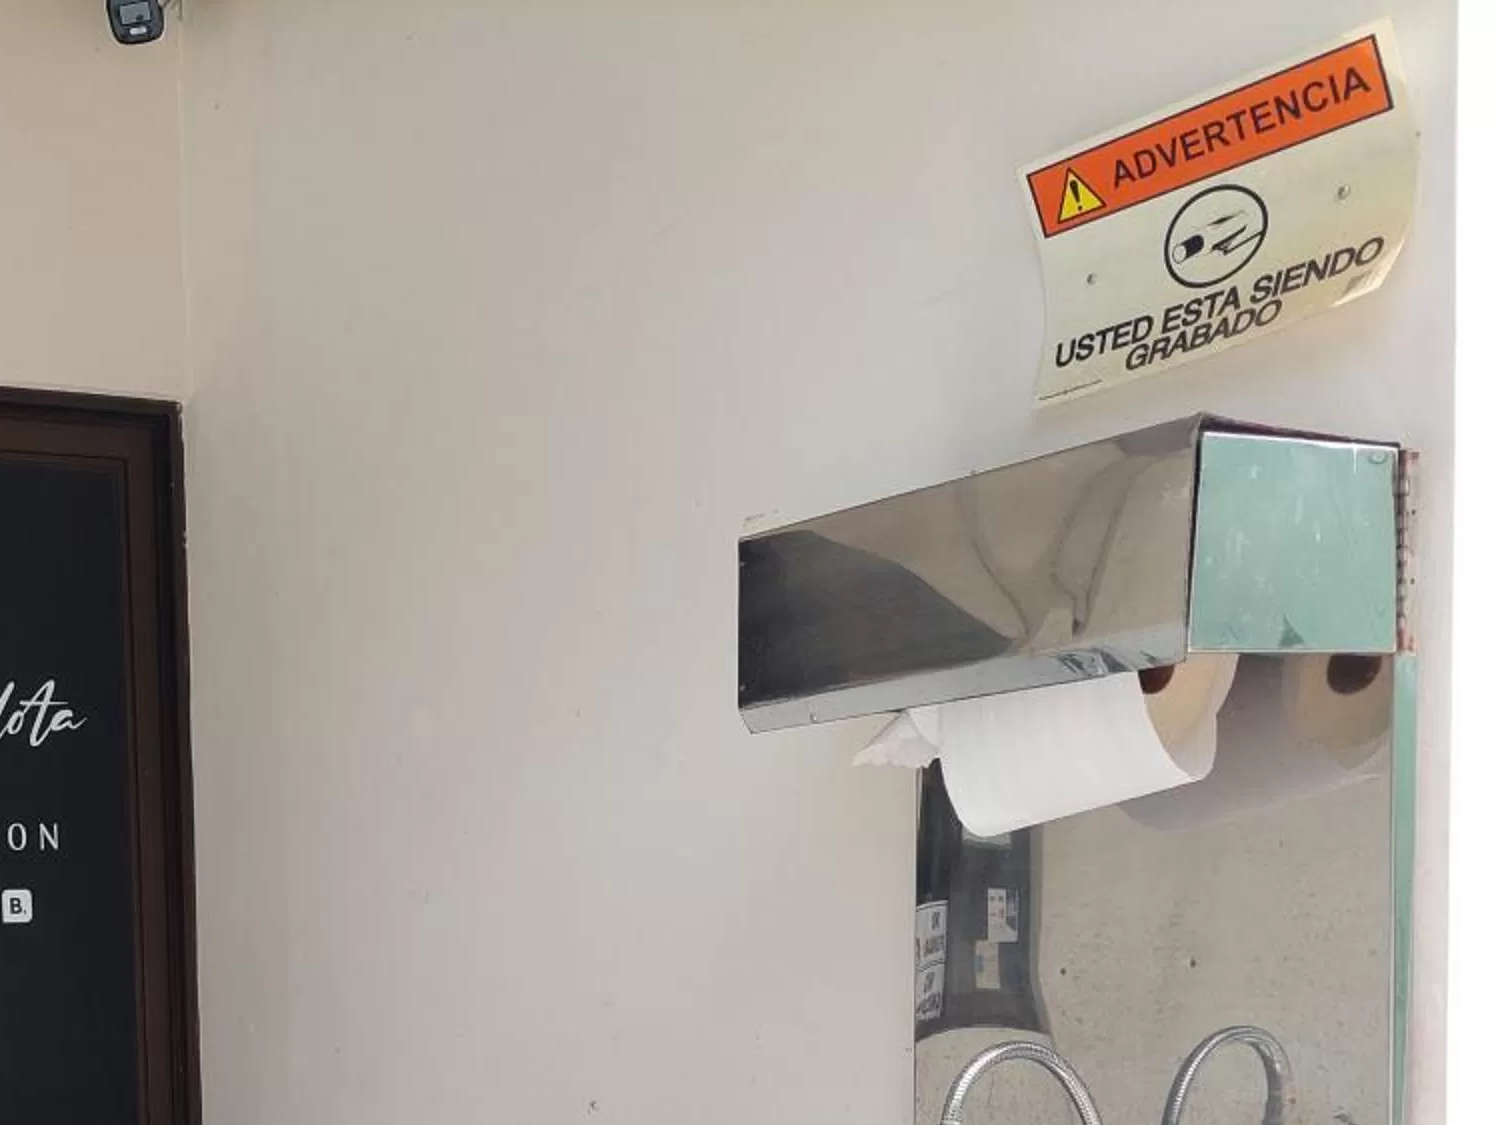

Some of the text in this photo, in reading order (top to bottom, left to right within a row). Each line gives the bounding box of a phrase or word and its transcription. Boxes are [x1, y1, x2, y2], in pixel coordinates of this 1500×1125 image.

[1113, 66, 1372, 191] ADVERTENCIA
[1055, 236, 1385, 368] USTED ESTA SIENDO
[1125, 299, 1284, 372] GRABADO
